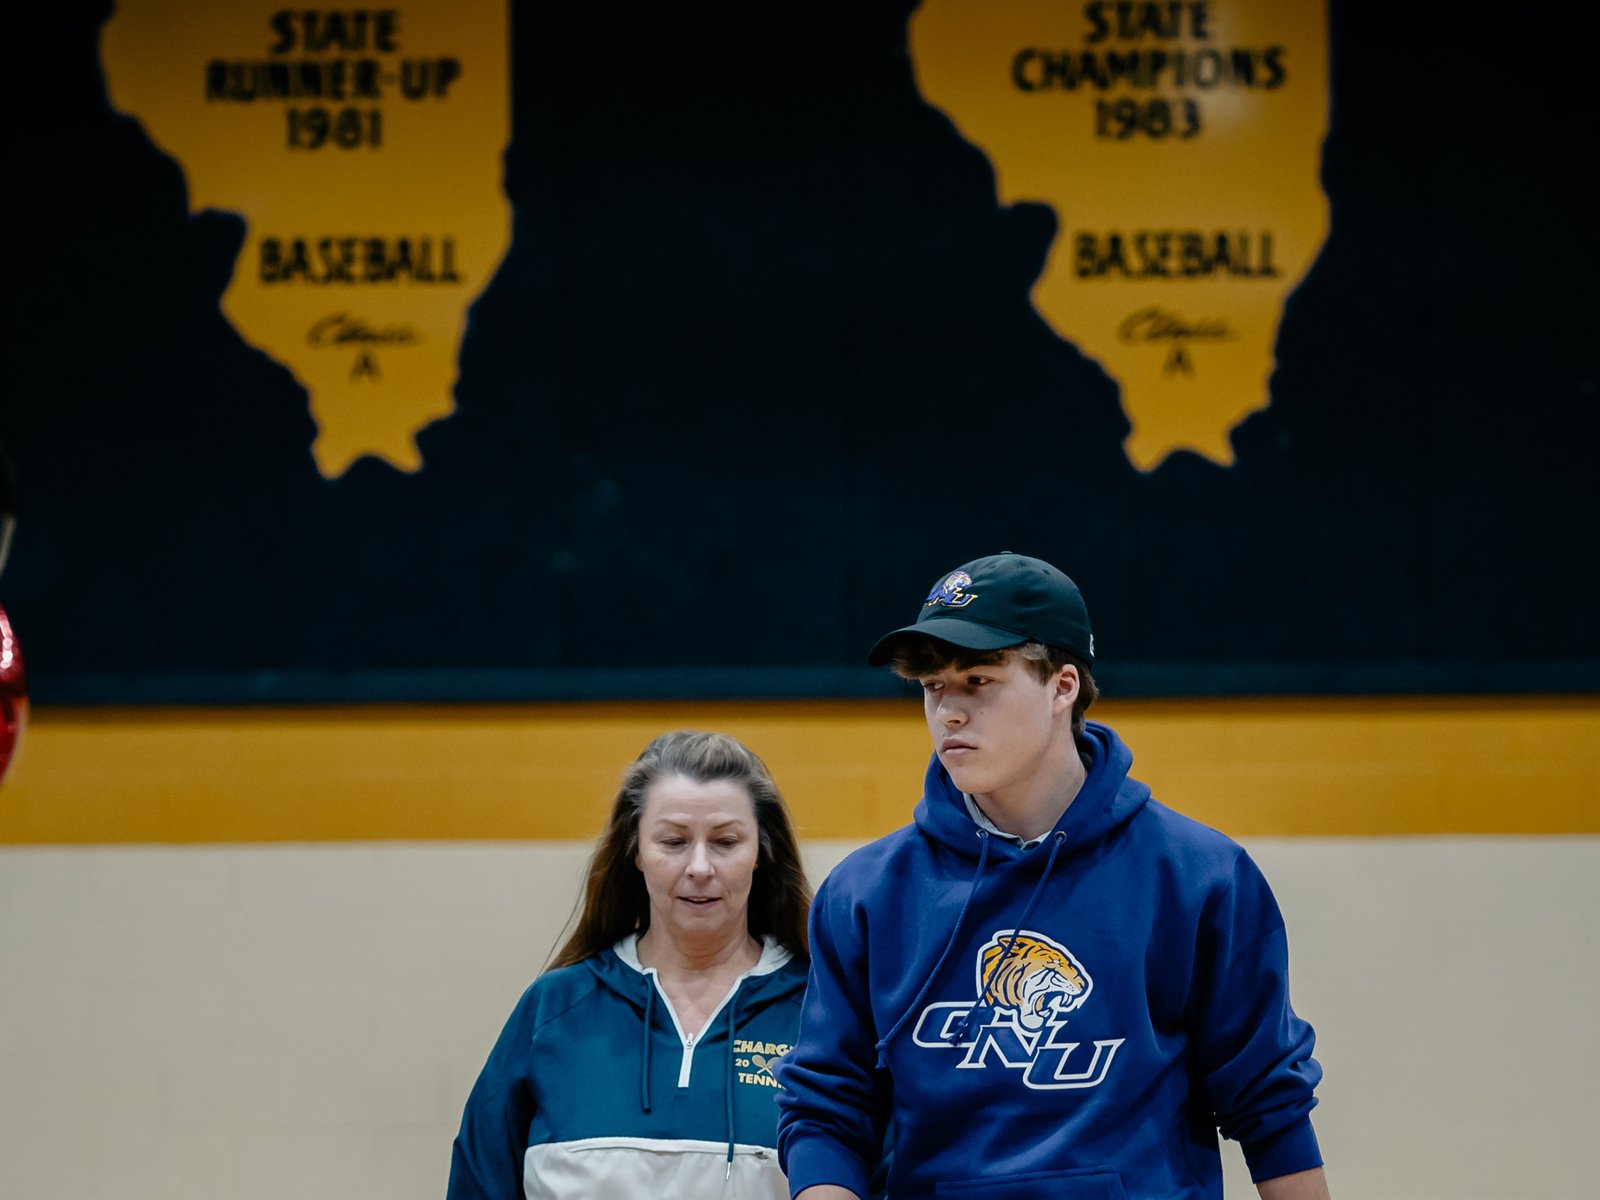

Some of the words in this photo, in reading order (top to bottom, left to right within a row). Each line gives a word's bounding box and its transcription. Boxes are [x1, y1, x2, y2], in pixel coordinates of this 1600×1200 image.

[271, 11, 398, 53] STATE
[1085, 1, 1210, 41] STATE
[206, 59, 461, 101] RUNNER-UP
[1011, 47, 1287, 92] CHAMPIONS
[287, 109, 381, 149] 1981
[1097, 98, 1201, 139] 1983
[261, 237, 462, 284] BASEBALL
[1076, 231, 1280, 279] BASEBALL
[351, 353, 380, 382] A
[1165, 348, 1193, 378] A
[733, 1039, 796, 1056] CHARG
[735, 1058, 750, 1068] 20
[738, 1072, 786, 1090] TENN
